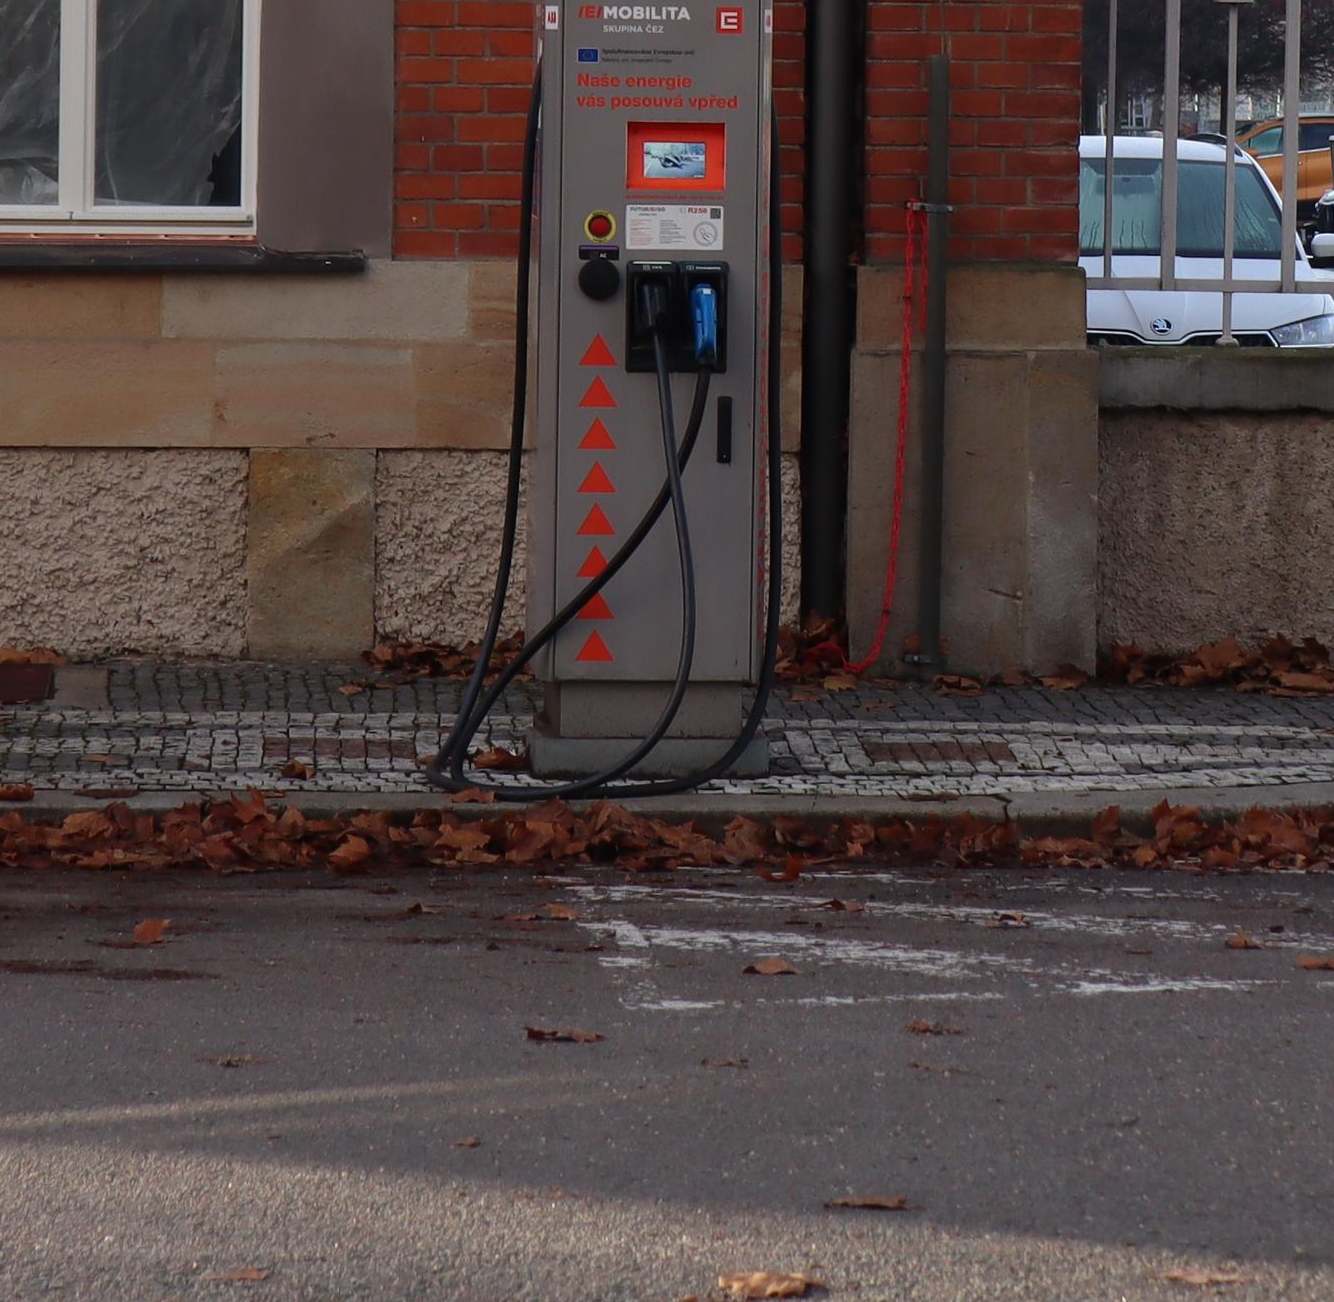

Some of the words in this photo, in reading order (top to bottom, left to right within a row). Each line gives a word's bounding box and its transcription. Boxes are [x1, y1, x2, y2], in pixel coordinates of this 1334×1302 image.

[603, 25, 643, 34] SKUPINA
[645, 24, 664, 34] ČEZ
[577, 73, 620, 87] Naše
[625, 74, 692, 90] energie
[576, 93, 605, 107] vás
[611, 94, 683, 110] posouvá
[689, 93, 738, 110] vpřed
